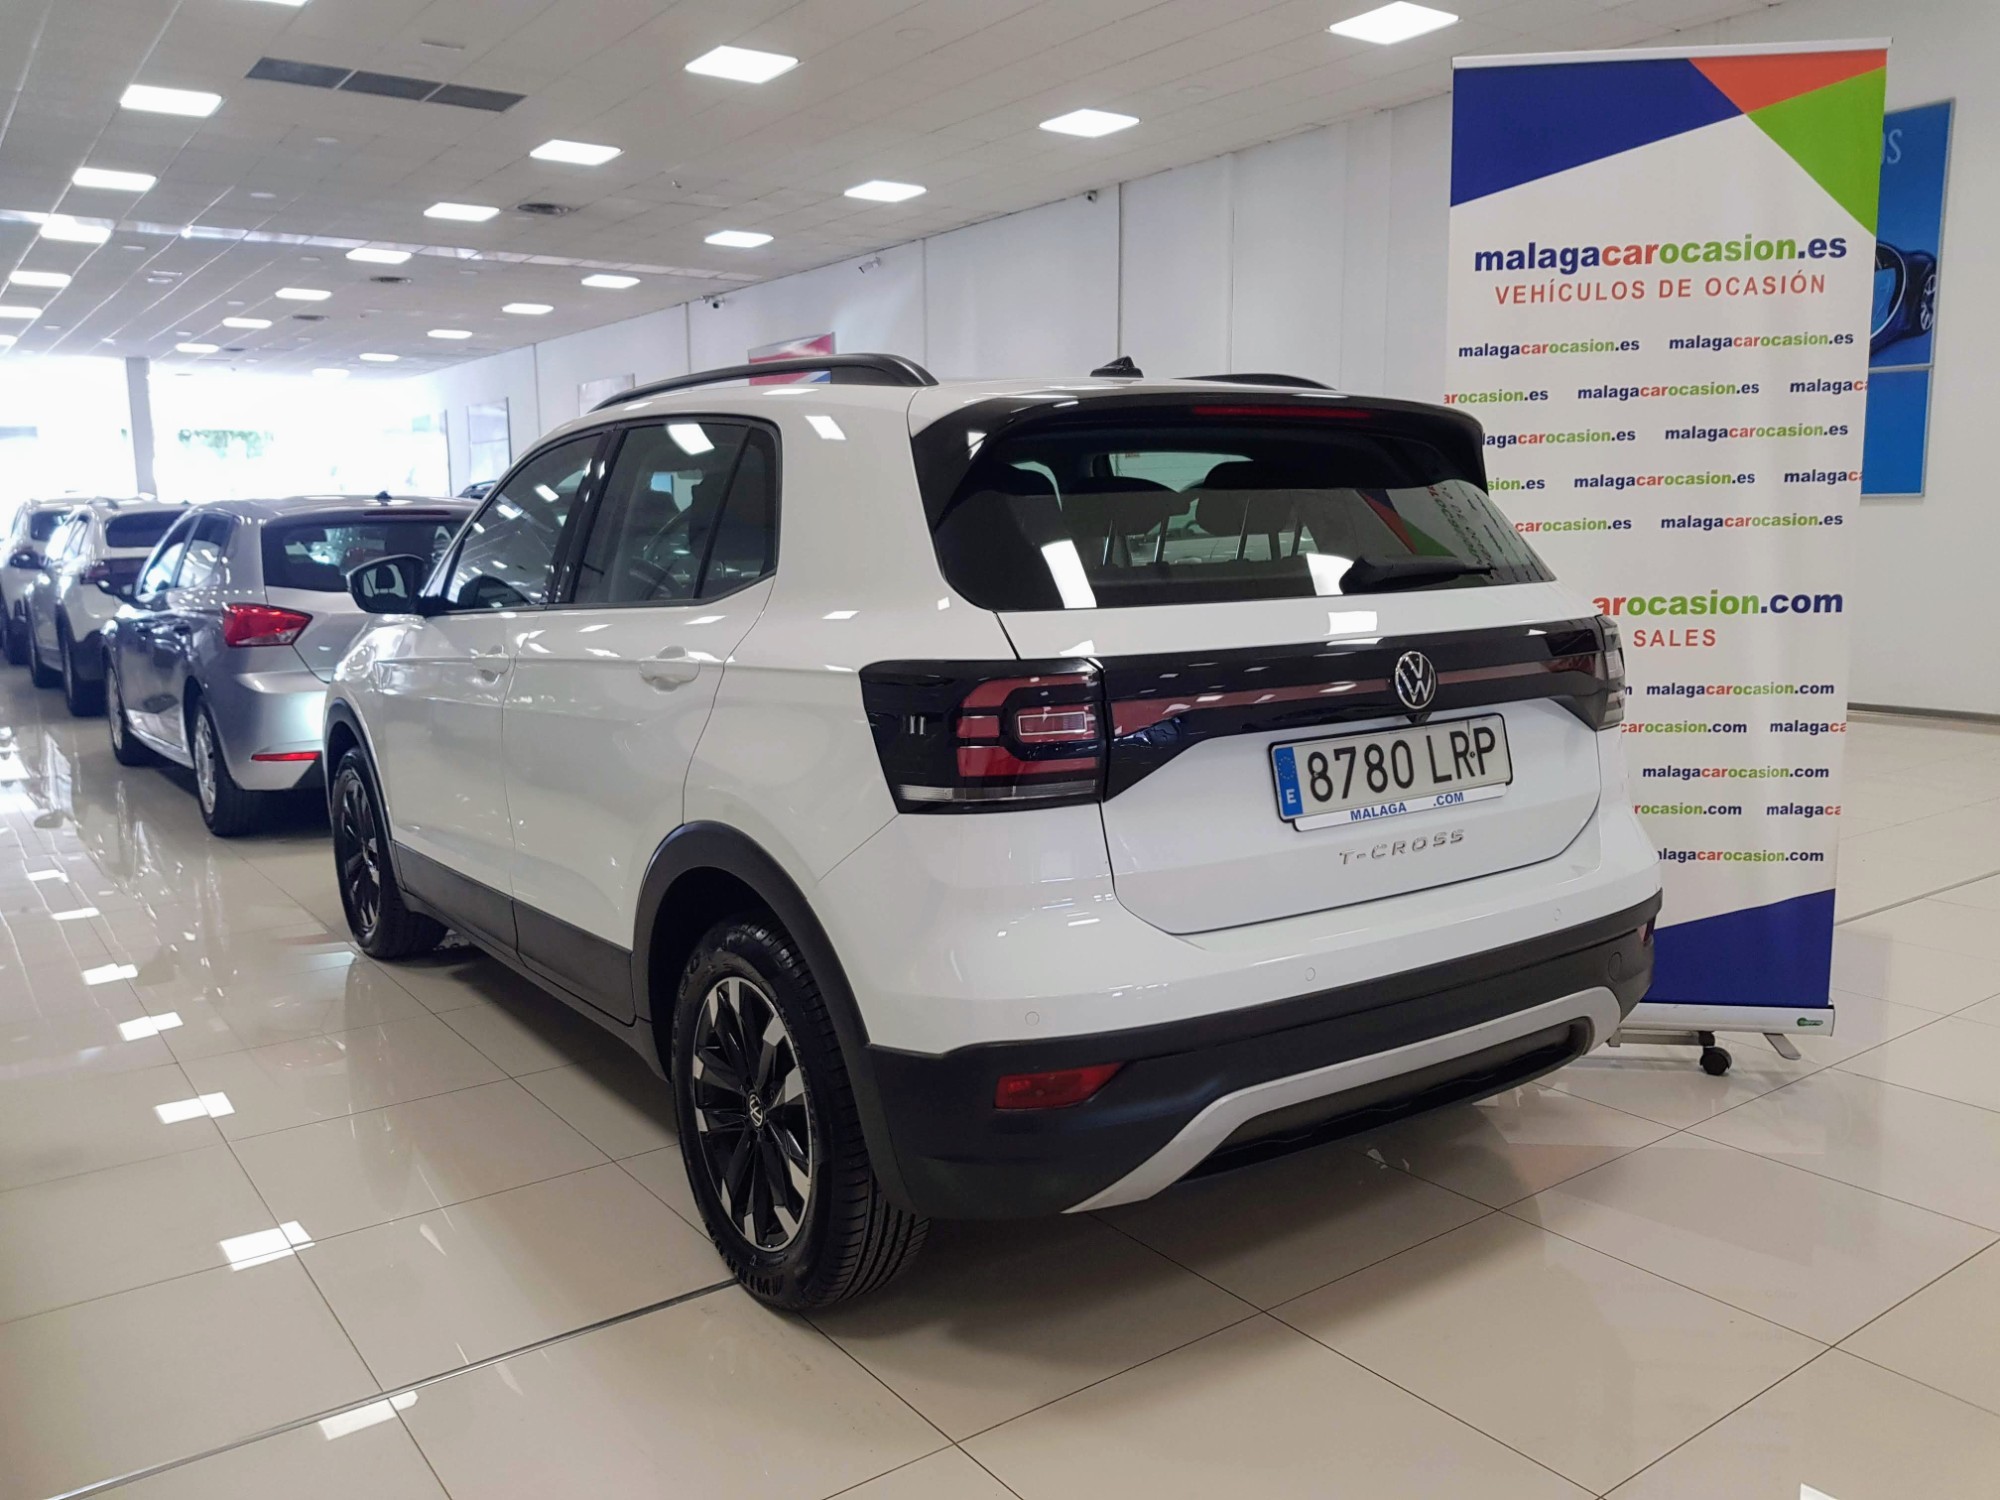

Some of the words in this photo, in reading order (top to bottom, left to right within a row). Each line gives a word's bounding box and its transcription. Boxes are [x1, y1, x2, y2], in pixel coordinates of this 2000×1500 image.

[1475, 234, 1847, 275] malagacarocasion.es
[1495, 279, 1646, 305] VEHÍCULOS
[1659, 279, 1692, 299] DE
[1705, 269, 1826, 297] OCASIÓN
[1458, 337, 1640, 359] malagacarocasion.es
[1669, 331, 1854, 352] malagacarocasion.es
[1577, 380, 1760, 402] malagacarocasion.es
[1664, 423, 1848, 443] malagacarocasion.es
[1574, 471, 1756, 491] malagacarocasion.es
[1515, 517, 1632, 533] carocasion.es
[1660, 512, 1844, 532] malagacarocasion.es
[1633, 628, 1717, 648] SALES
[1646, 682, 1835, 699] malagacarocasion.com
[1307, 739, 1414, 802] 8780
[1426, 726, 1496, 784] LRP
[1642, 765, 1830, 781] malagacarocasion.com
[1285, 789, 1297, 805] E
[1350, 802, 1408, 821] MALAGA
[1433, 792, 1464, 807] .COM
[1339, 829, 1464, 865] T-CROSS
